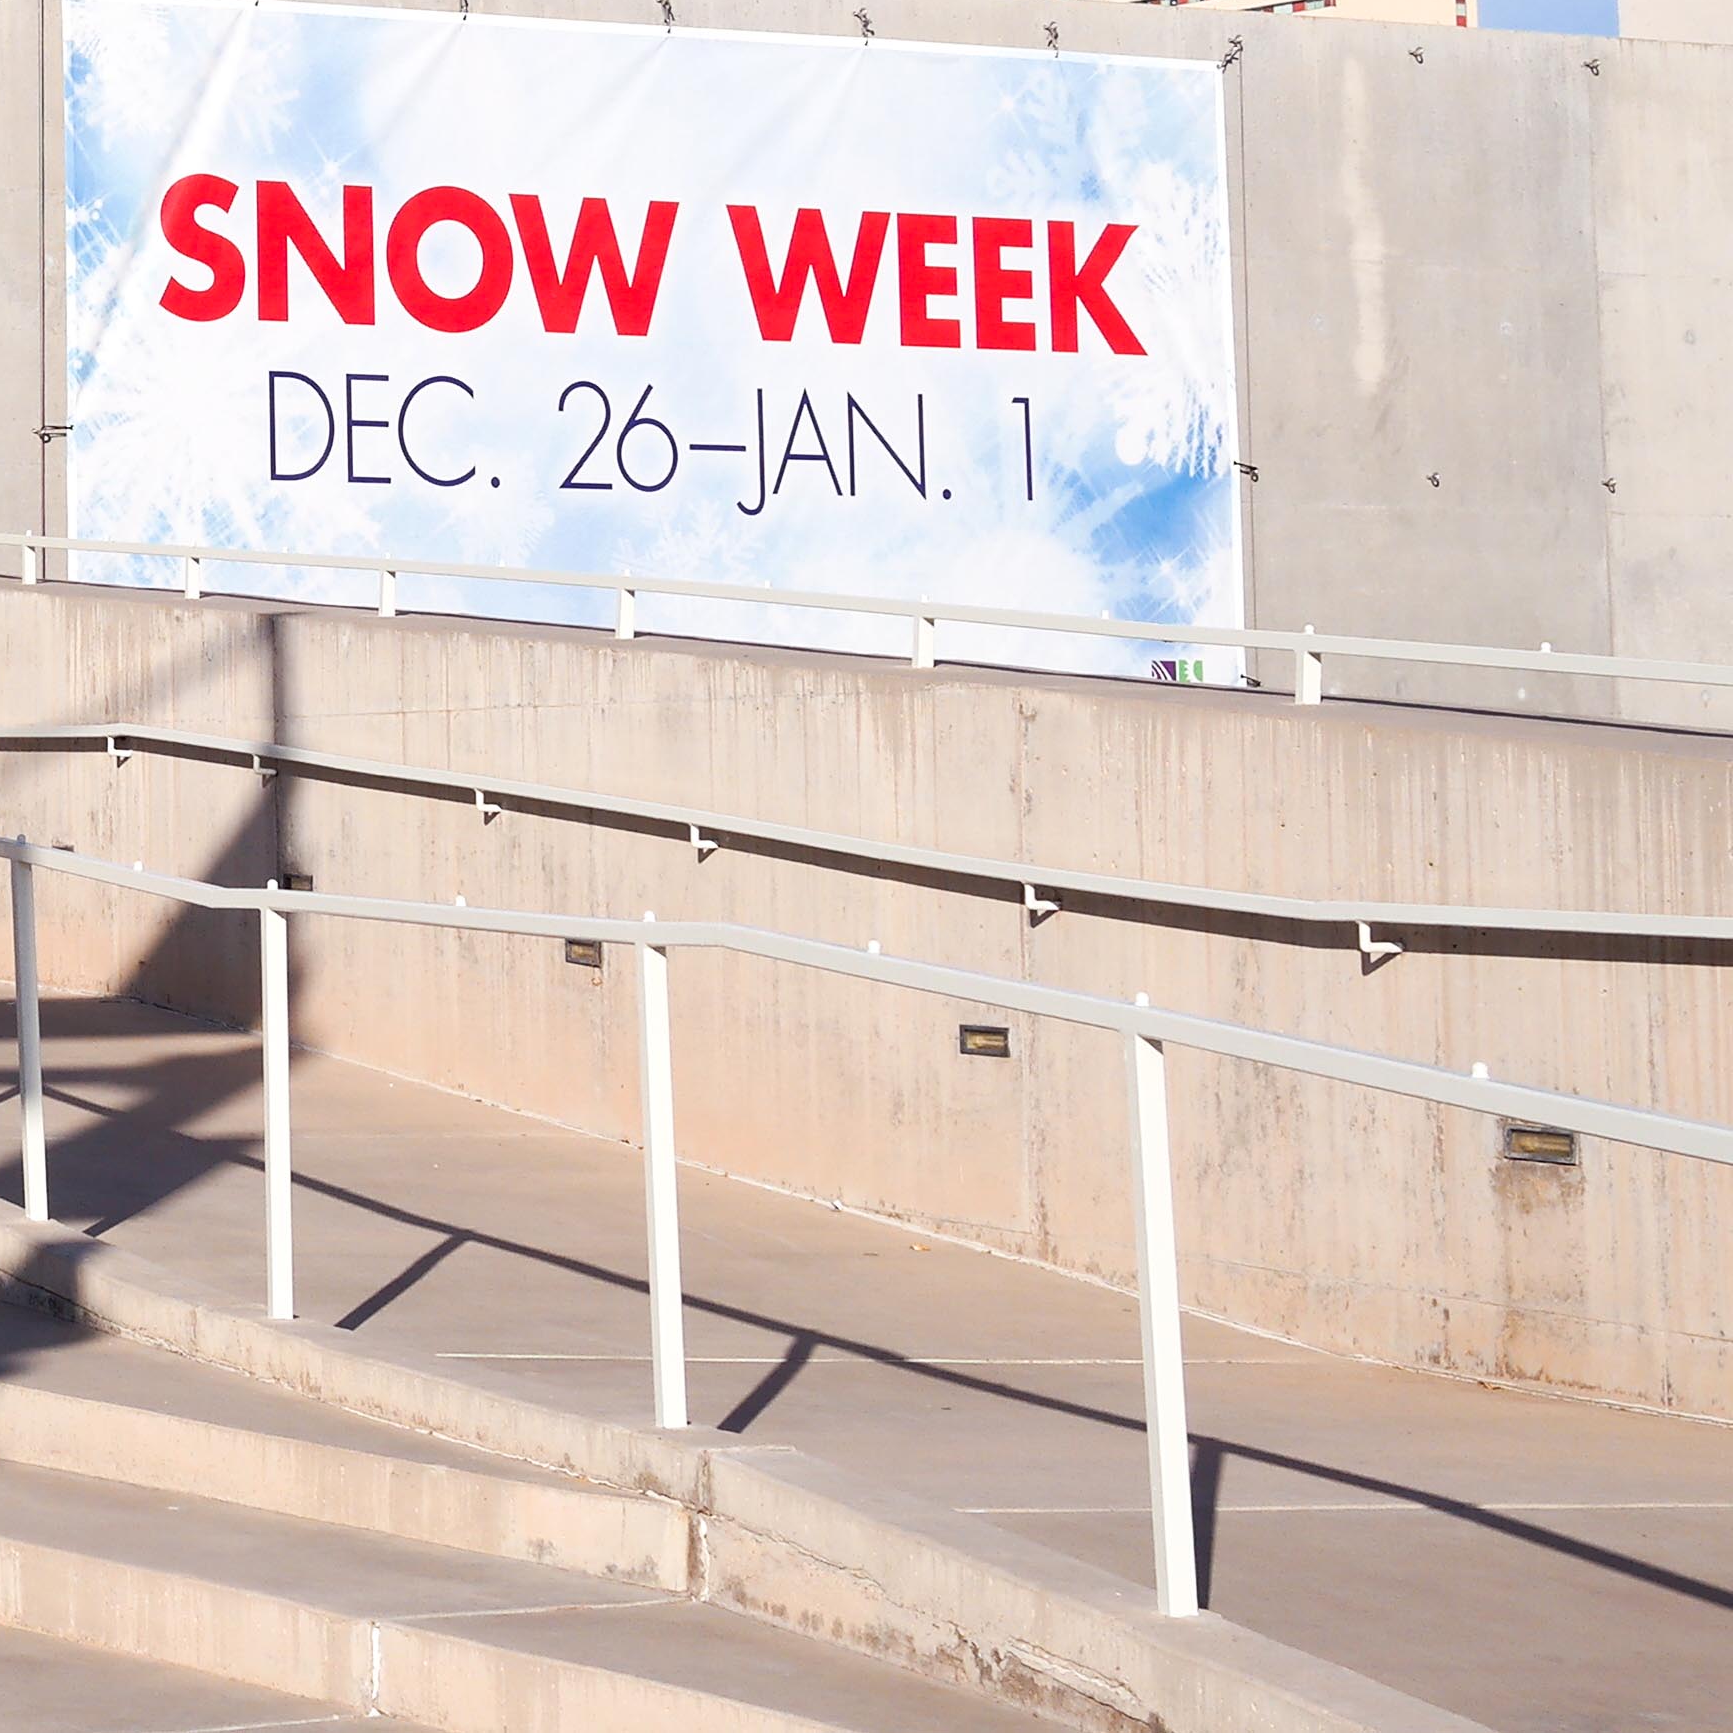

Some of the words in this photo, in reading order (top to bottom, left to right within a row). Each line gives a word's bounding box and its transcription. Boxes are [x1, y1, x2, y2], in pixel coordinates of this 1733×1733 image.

[158, 173, 680, 337] SNOW
[725, 203, 1149, 357] WEEK
[270, 370, 501, 490] DEC.
[1012, 397, 1034, 502] 1
